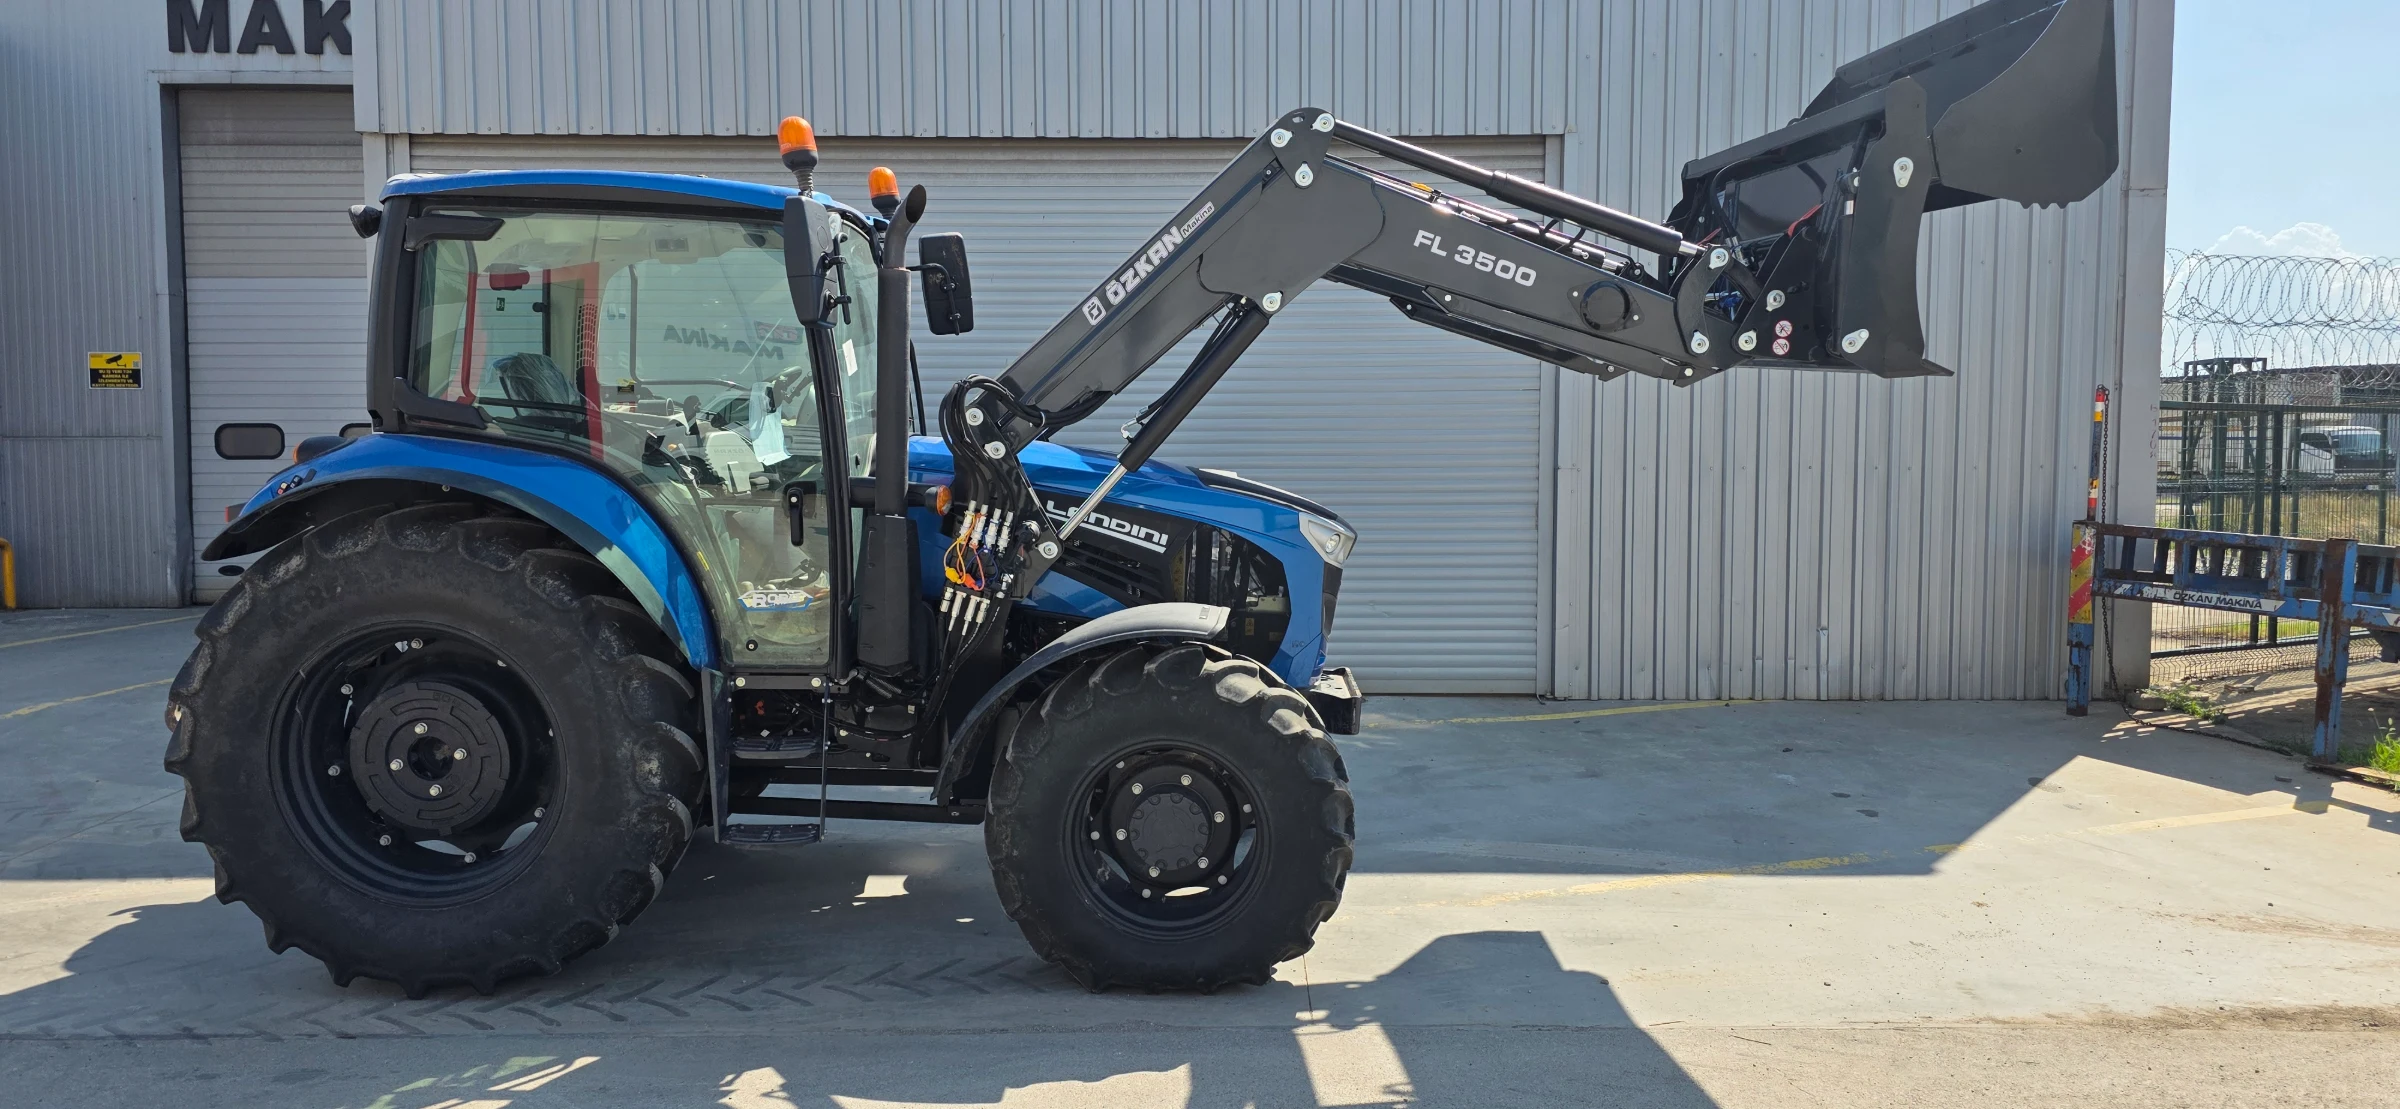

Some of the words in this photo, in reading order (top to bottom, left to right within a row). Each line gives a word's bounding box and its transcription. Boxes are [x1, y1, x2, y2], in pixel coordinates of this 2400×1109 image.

[166, 0, 352, 55] MAK
[1105, 225, 1184, 306] ÖZKAN
[1182, 204, 1214, 237] Makina
[1413, 229, 1447, 257] FL
[1454, 244, 1537, 287] 3500
[2173, 590, 2213, 604] ÖZKAN
[2215, 594, 2262, 610] MAKİNA
